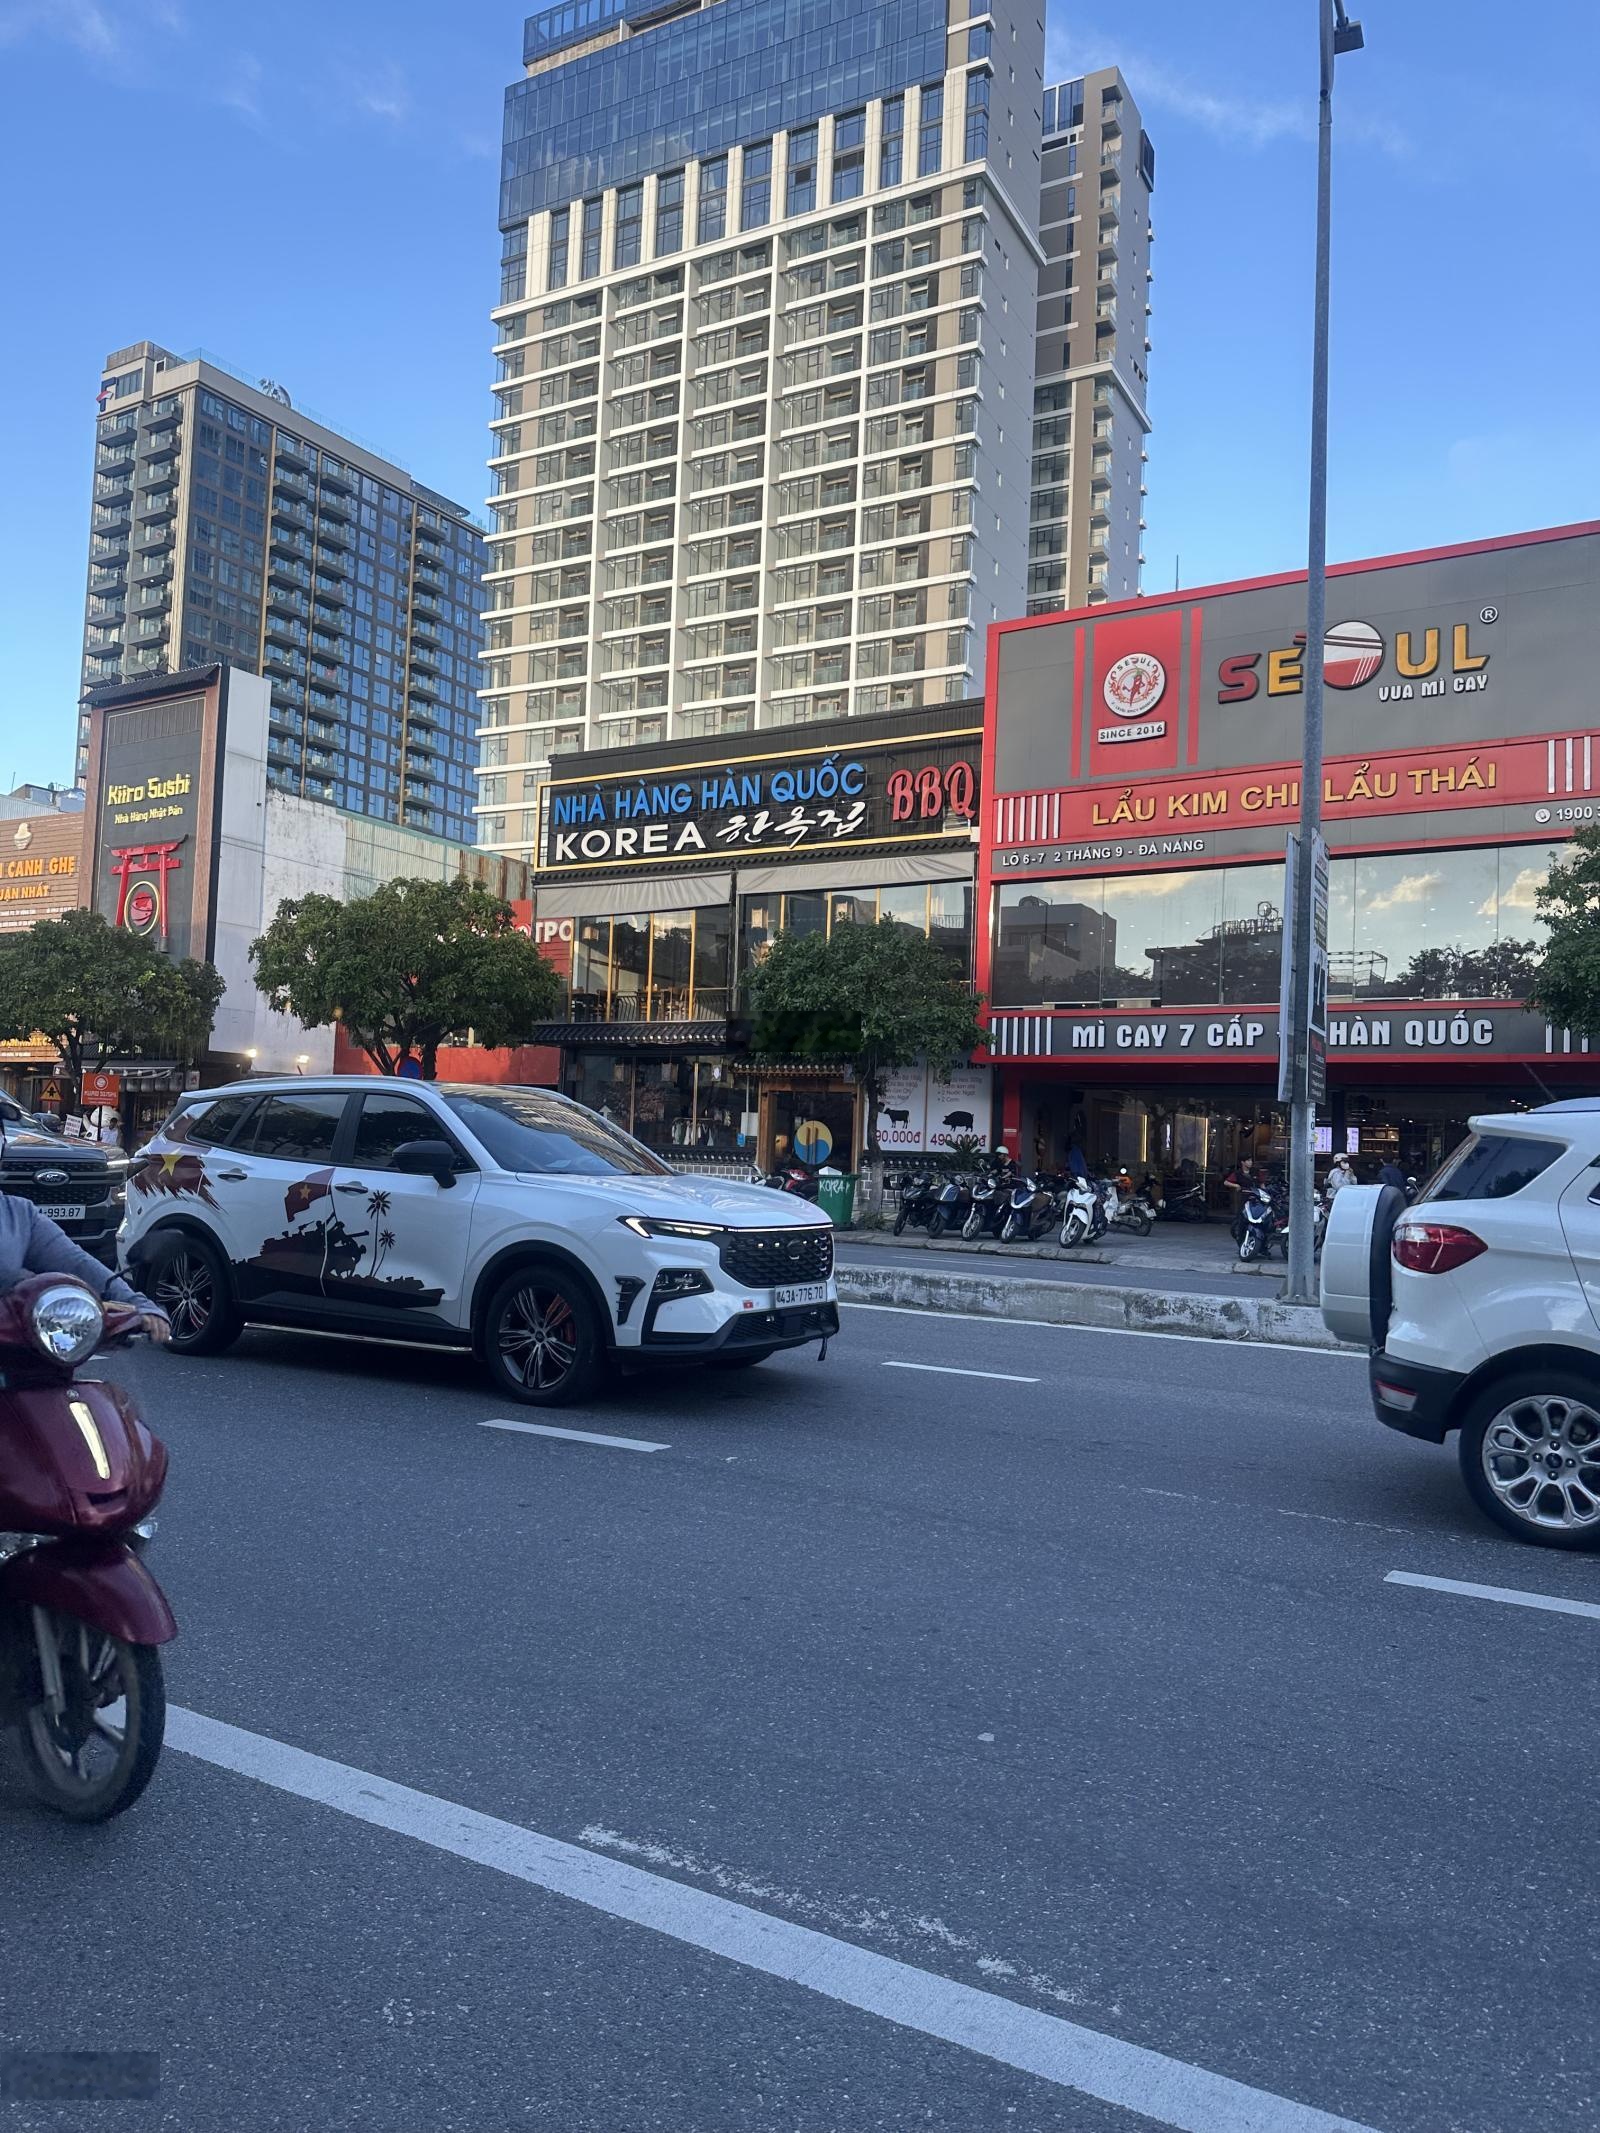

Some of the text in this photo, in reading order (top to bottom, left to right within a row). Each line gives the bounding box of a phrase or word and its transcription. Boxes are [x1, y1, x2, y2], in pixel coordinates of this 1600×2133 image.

[1378, 674, 1488, 702] VUA MÌ CAY
[1100, 724, 1163, 740] SINCE 2016
[107, 773, 191, 805] Kiiro Sushi
[554, 752, 864, 825] NHÀ HÀNG HÀN QUỐC
[887, 760, 975, 821] BBQ
[1092, 756, 1496, 826] LẨU KIM CHI LẨU THÁI
[1556, 806, 1593, 820] 1900
[555, 821, 706, 861] KOREA
[1054, 852, 1062, 862] 2
[1066, 846, 1111, 861] THÁNG
[1115, 848, 1124, 858] 9
[8, 858, 43, 878] CANH
[49, 855, 76, 877] GHẸ
[1072, 1009, 1493, 1048] MÌ CAY 7 CẤP HÀN QUỐC
[875, 1130, 921, 1144] 90,000đ
